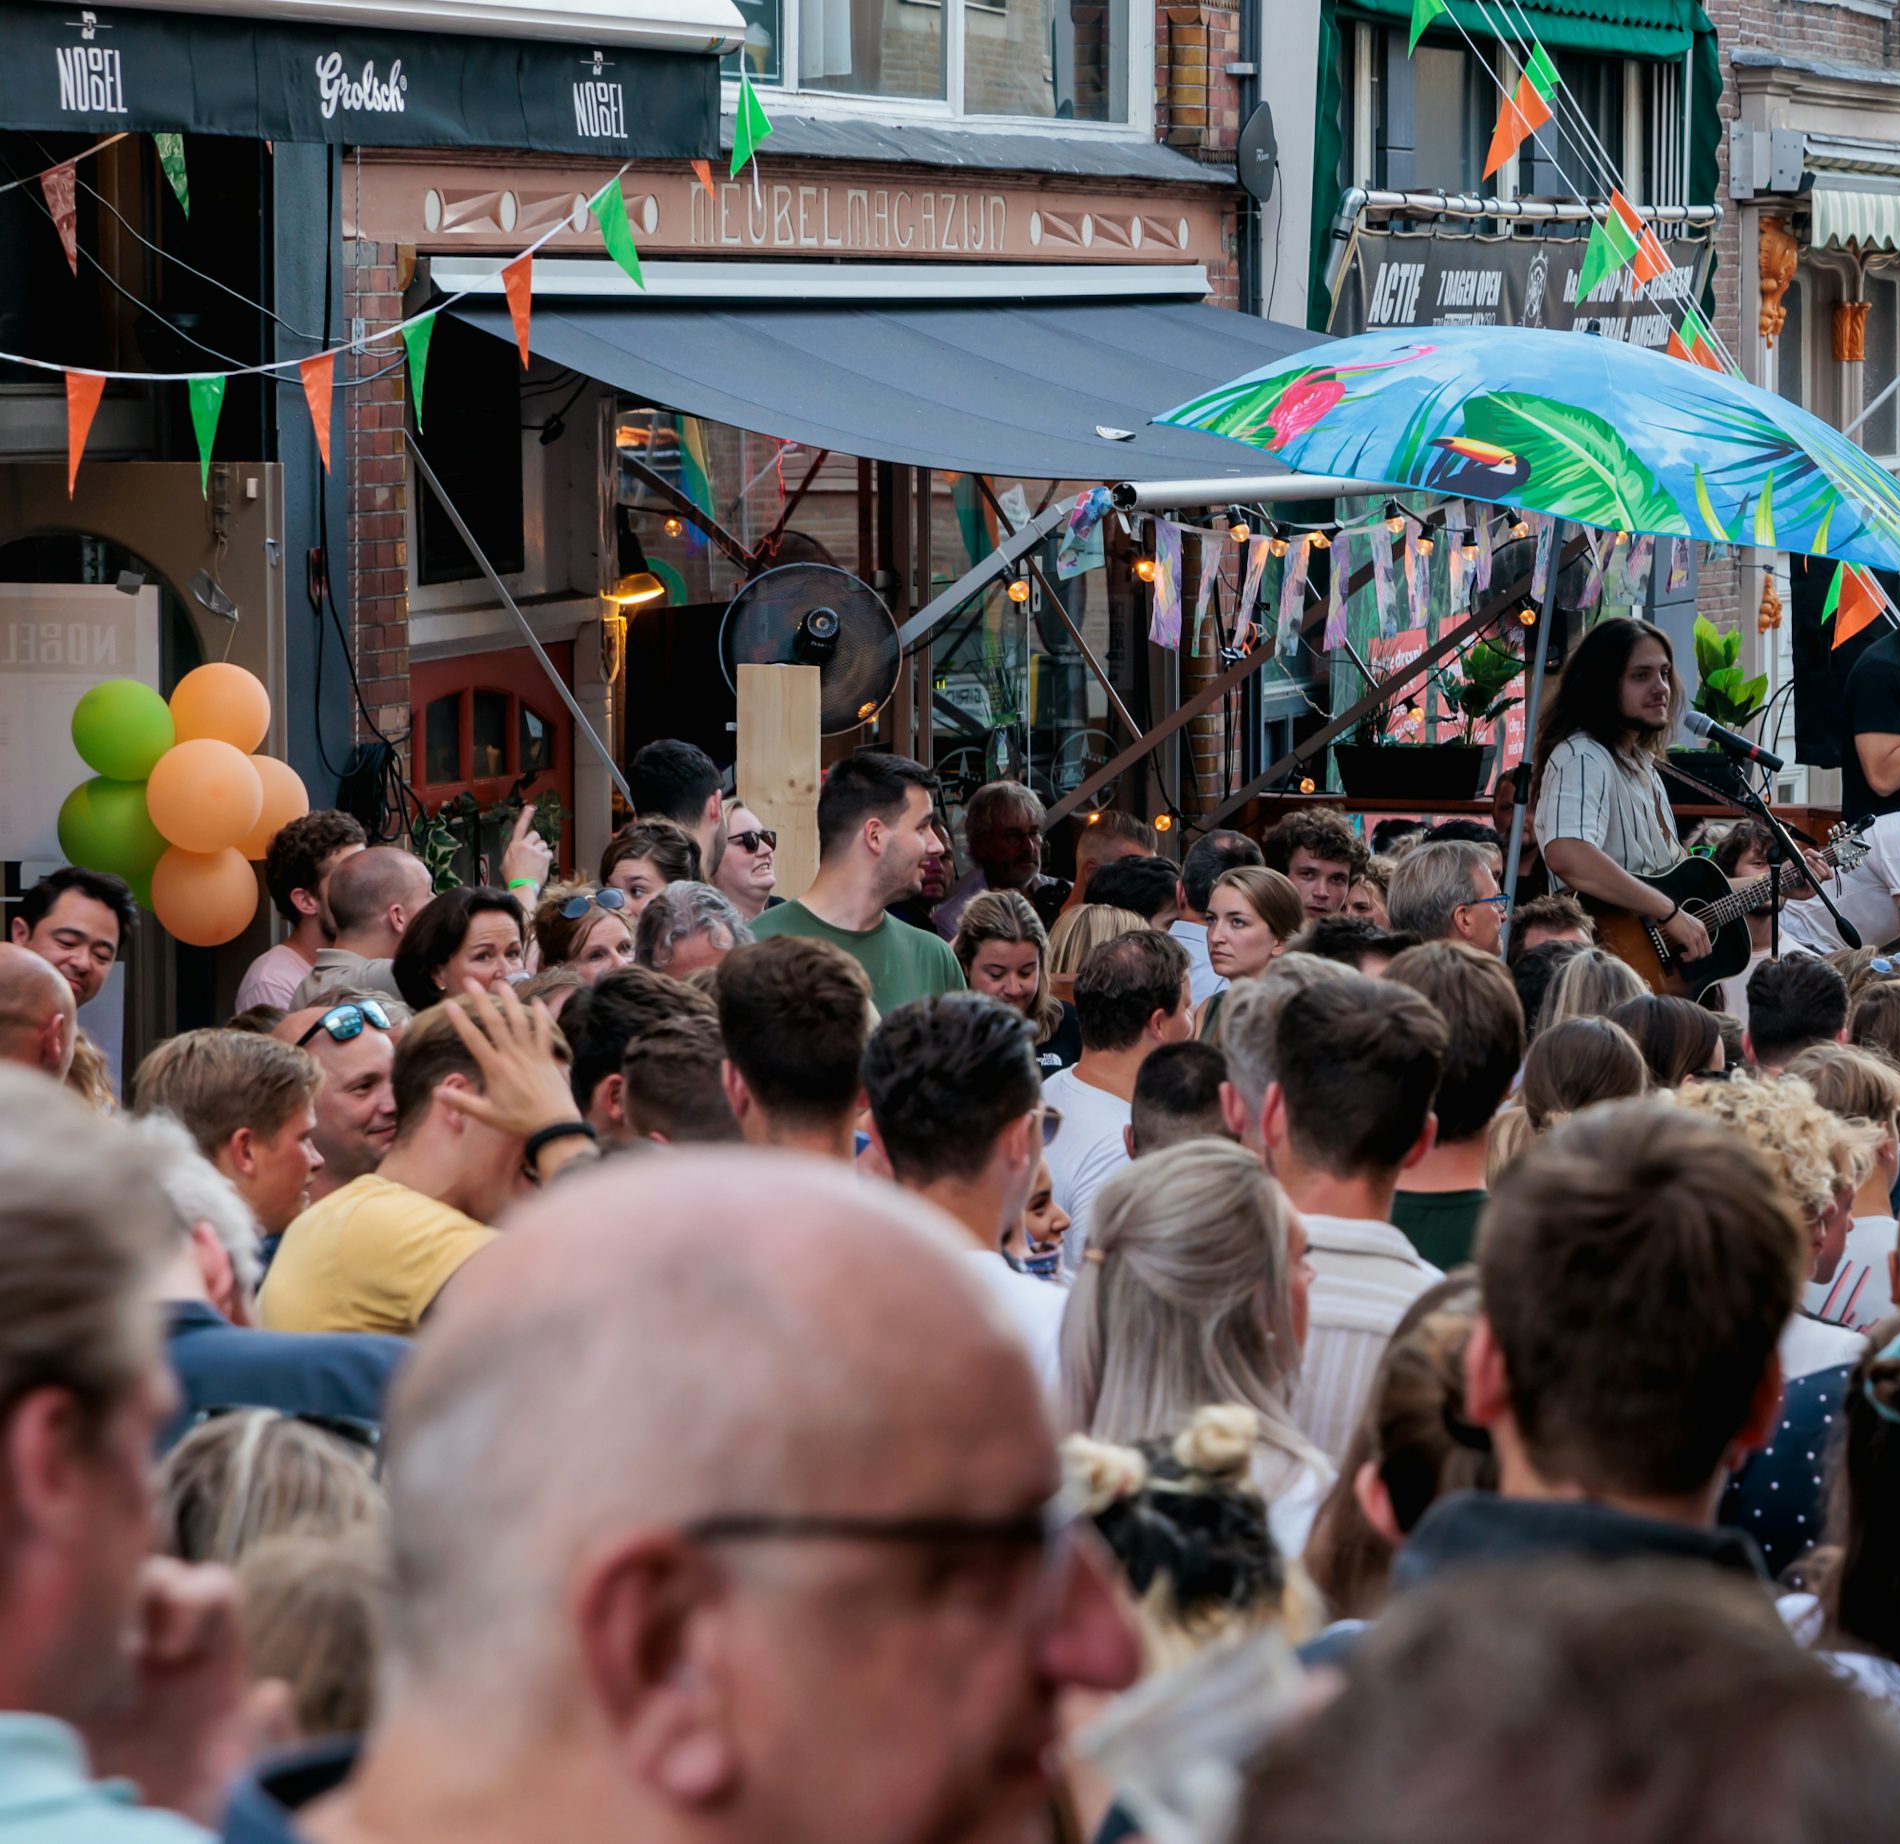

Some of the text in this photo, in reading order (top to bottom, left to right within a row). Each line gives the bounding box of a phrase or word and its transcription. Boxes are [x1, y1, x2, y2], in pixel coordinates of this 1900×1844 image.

[56, 47, 128, 113] NOBEL
[573, 81, 628, 138] NOBEL
[1367, 262, 1425, 325] ACTIE
[1443, 271, 1478, 306] DAGEN
[1475, 271, 1502, 306] OPEN
